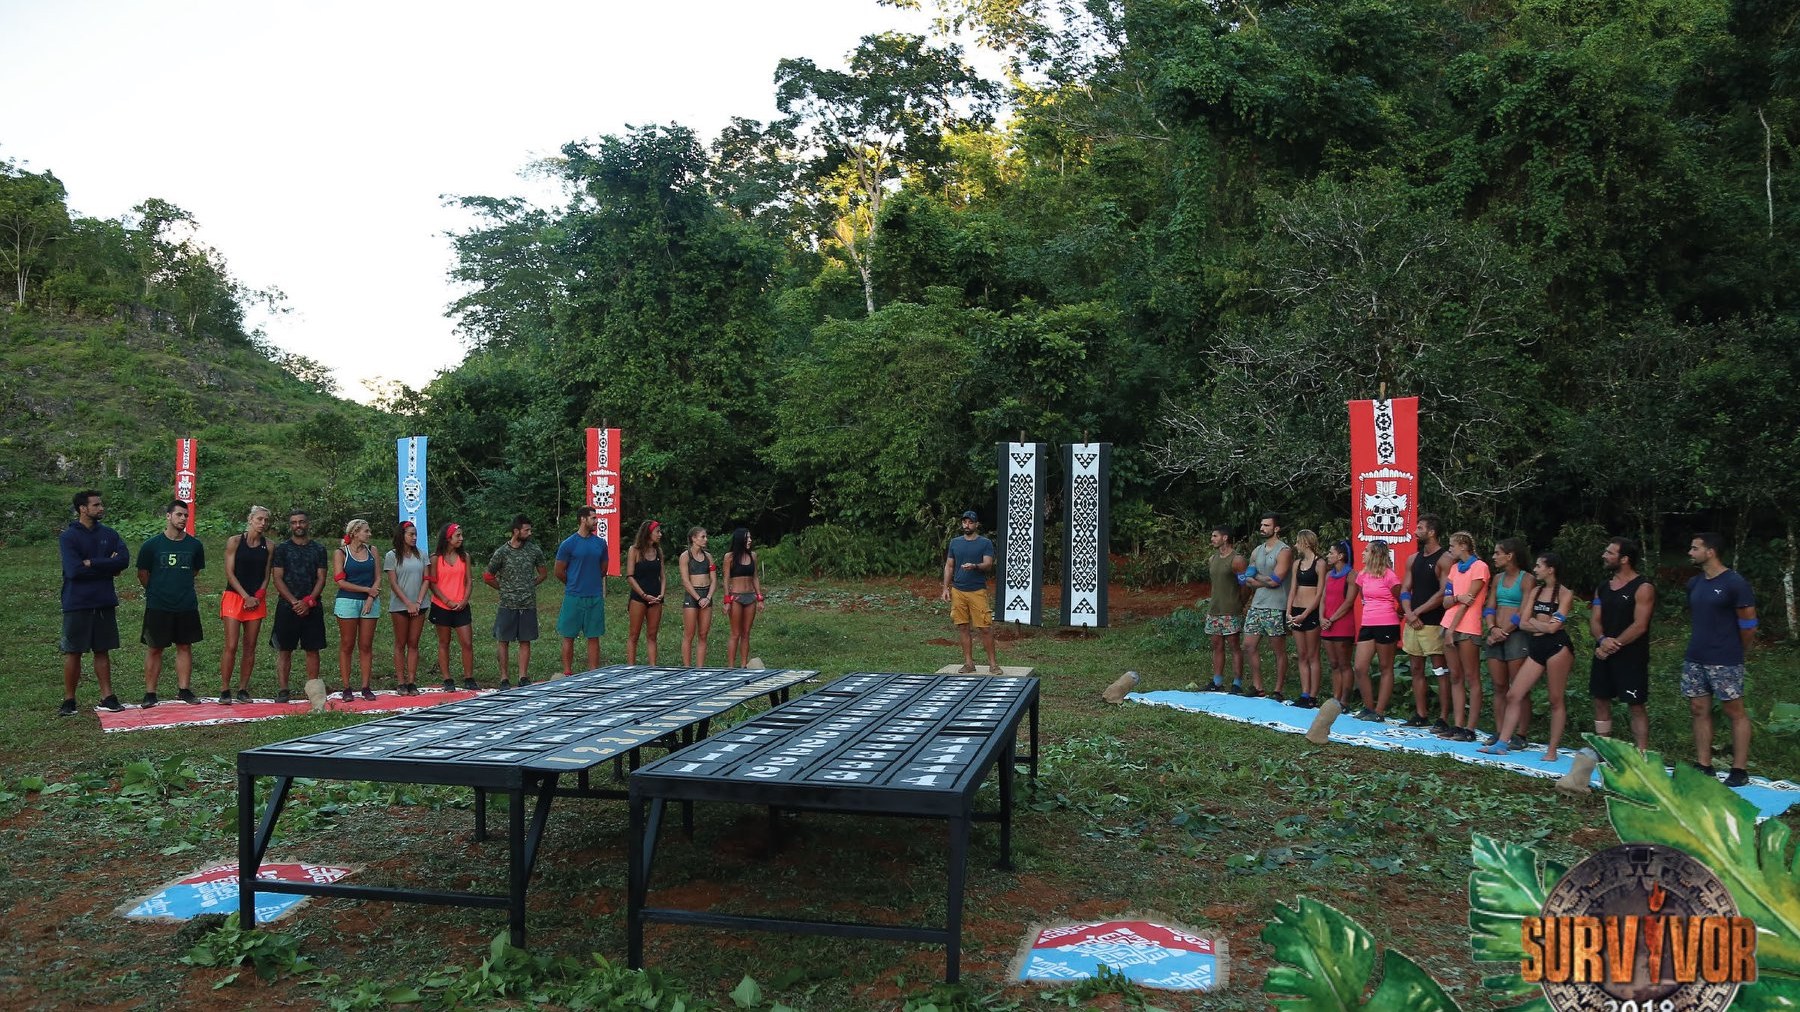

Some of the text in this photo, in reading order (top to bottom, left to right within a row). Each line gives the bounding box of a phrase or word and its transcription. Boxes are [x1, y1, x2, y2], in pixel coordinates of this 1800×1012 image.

[168, 554, 176, 566] 5
[796, 739, 827, 747] 2
[573, 746, 615, 754] 2
[764, 757, 798, 765] 2
[923, 755, 957, 763] 4
[675, 763, 702, 772] 1
[744, 766, 781, 777] 2
[824, 771, 861, 780] 3
[901, 775, 938, 786] 4
